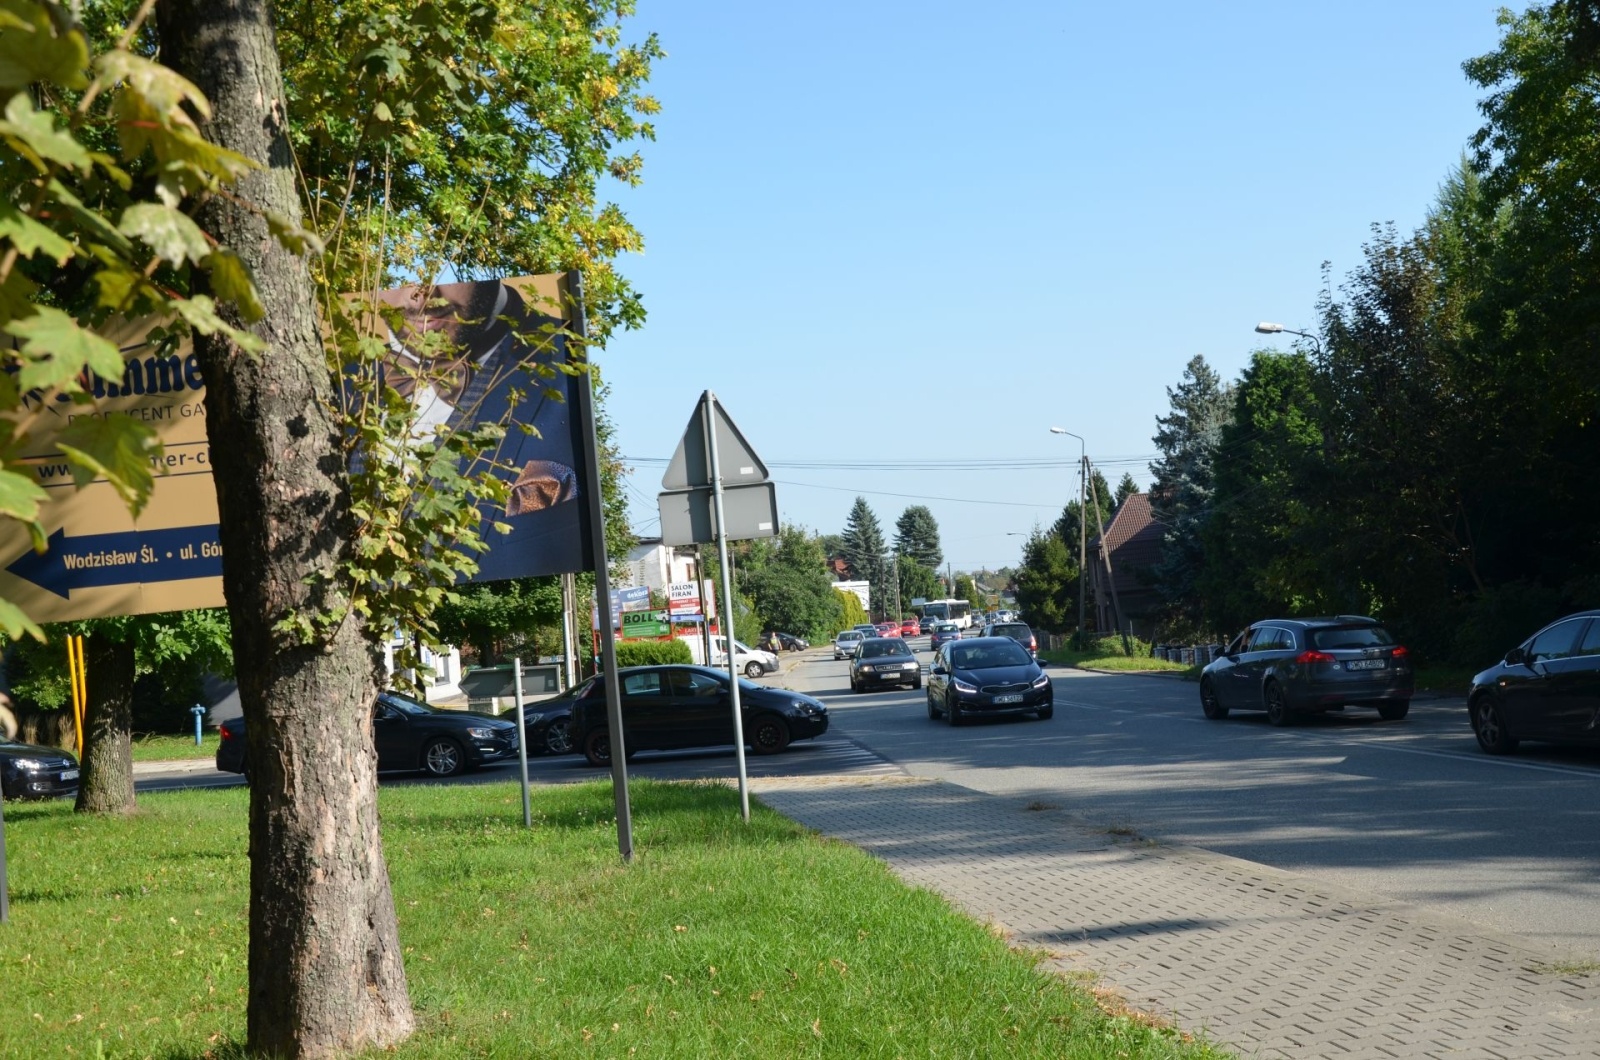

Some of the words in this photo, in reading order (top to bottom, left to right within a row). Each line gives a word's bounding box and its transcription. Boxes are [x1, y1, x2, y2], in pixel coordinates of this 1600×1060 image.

[63, 550, 137, 570] Wodzisław
[140, 544, 159, 563] Śl.
[180, 544, 198, 560] ul.
[671, 584, 693, 592] SALON
[623, 613, 654, 624] BOLL
